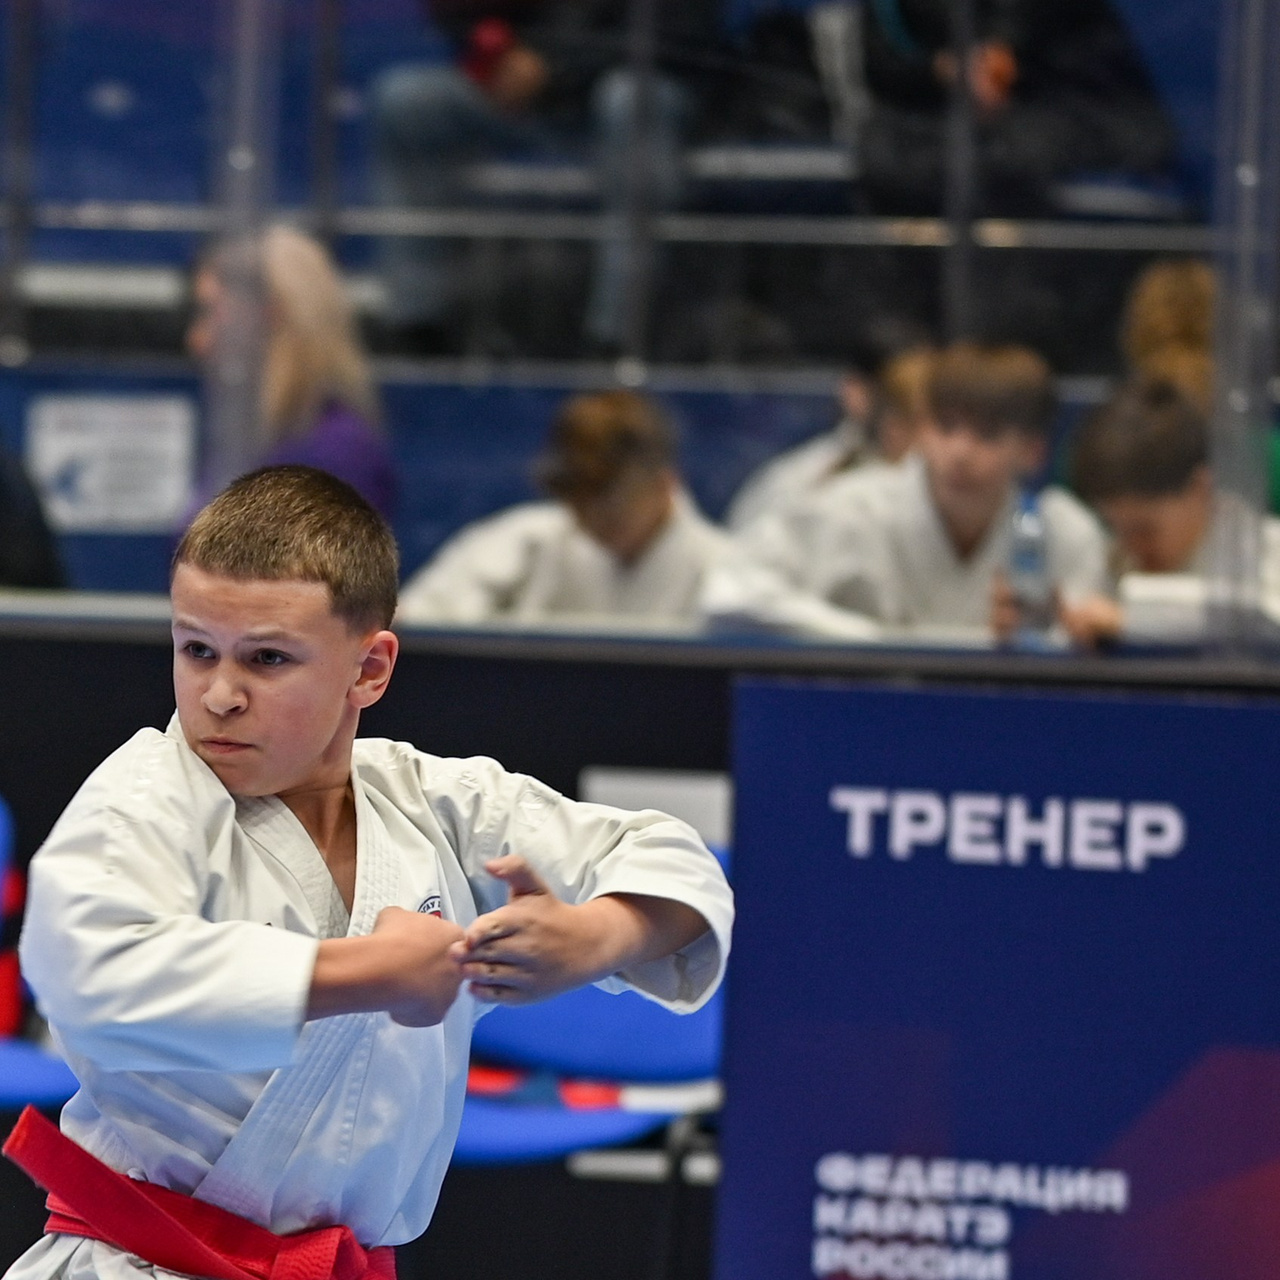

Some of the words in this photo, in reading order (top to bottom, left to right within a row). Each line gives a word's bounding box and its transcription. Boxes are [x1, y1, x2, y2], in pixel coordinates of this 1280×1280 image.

[829, 787, 1186, 872] ТРЕНЕР
[816, 1152, 1129, 1213] ФЕДЕРАЦИЯ
[814, 1196, 1010, 1243] КАРАТЭ
